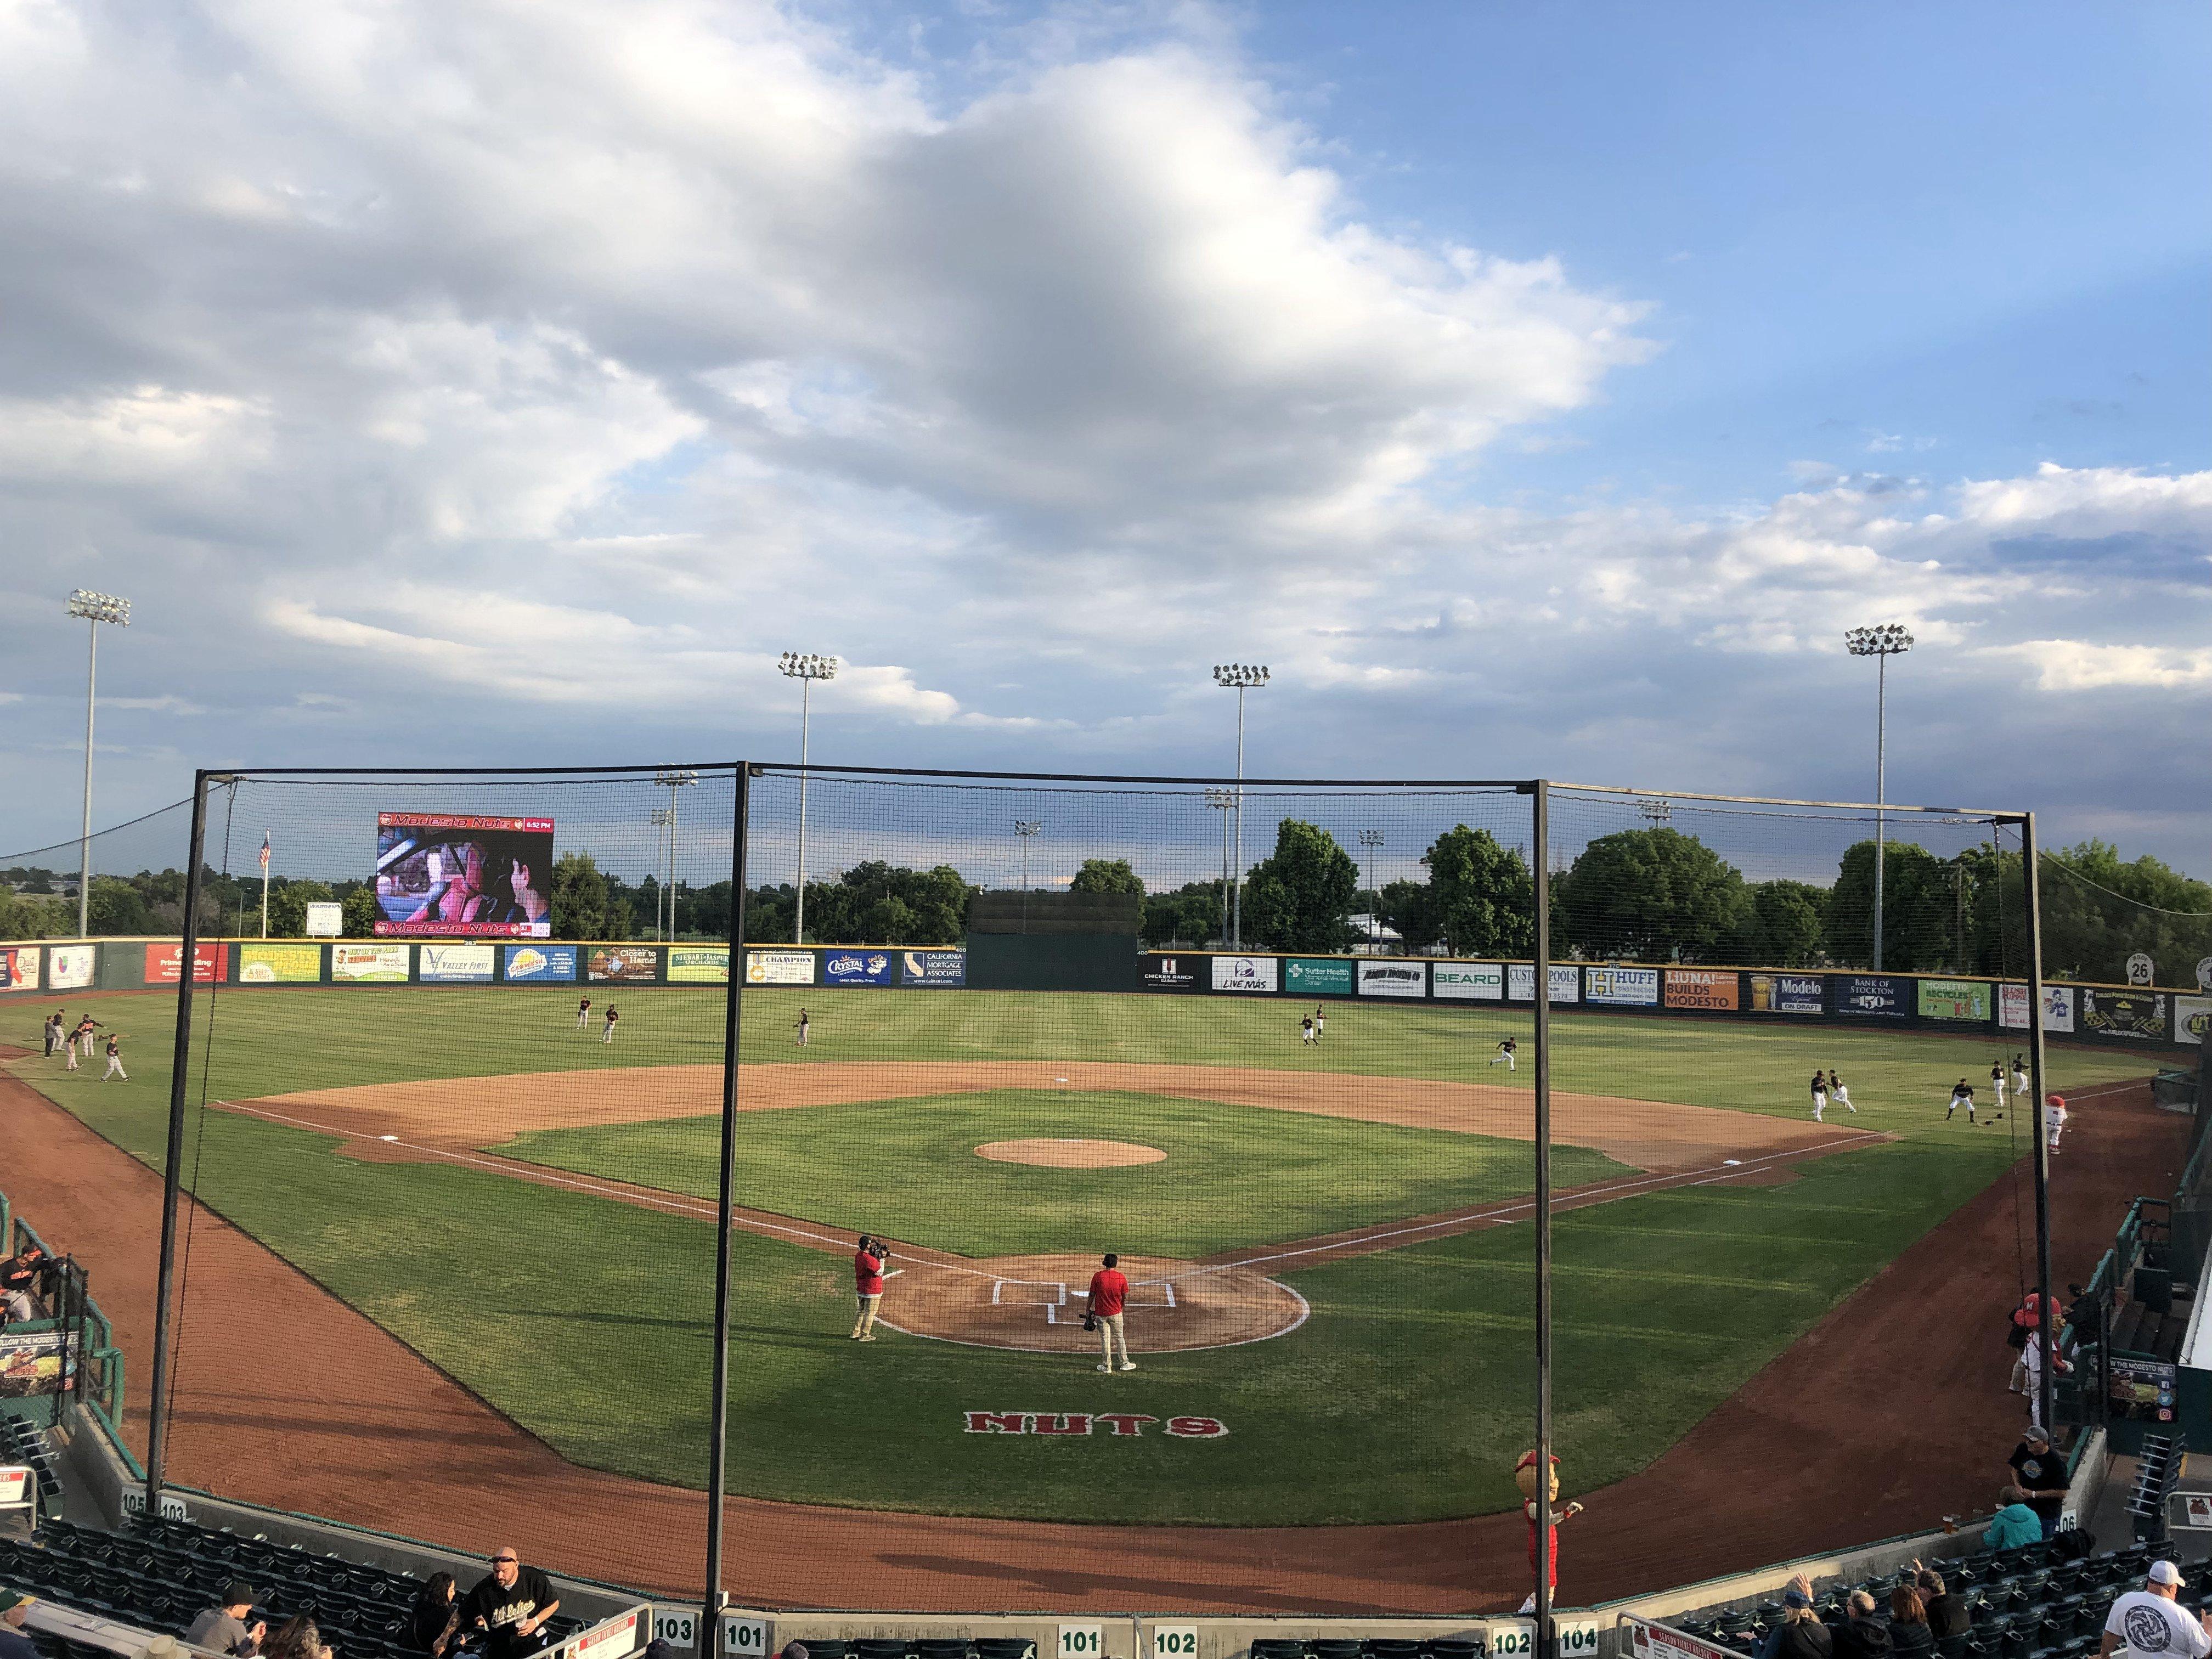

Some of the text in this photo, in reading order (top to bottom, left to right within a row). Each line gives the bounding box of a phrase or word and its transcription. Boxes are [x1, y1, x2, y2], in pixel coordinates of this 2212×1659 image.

[394, 815, 511, 828] Modesto Nuts
[390, 922, 507, 934] Modesto Nuts
[706, 953, 729, 962] JASPER
[828, 960, 864, 974] CRYSTAL
[2132, 963, 2148, 978] 26
[1435, 973, 1500, 984] BEARD
[1509, 969, 1577, 982] CUST POOLS
[1616, 972, 1656, 984] HUFF
[1223, 979, 1267, 989] LIVE MÁS
[1667, 984, 1710, 995] BUILDS
[1781, 979, 1821, 995] Modelo
[1850, 986, 1894, 995] STOCKTON
[1667, 995, 1728, 1007] MODESTO
[1859, 996, 1884, 1009] 150
[2129, 1363, 2156, 1372] MODESTO
[963, 1411, 1229, 1438] NUTS
[122, 1494, 145, 1512] 105
[163, 1504, 183, 1522] 103
[2063, 1515, 2075, 1531] 06
[491, 1599, 535, 1623] Athletics
[657, 1618, 691, 1640] 103
[729, 1625, 760, 1647] 101
[1063, 1632, 1097, 1652] 101
[1157, 1633, 1195, 1654] 102
[1496, 1633, 1530, 1654] 102
[1562, 1628, 1596, 1650] 104
[1659, 1632, 1677, 1645] SEASON
[1677, 1638, 1692, 1652] TICKET
